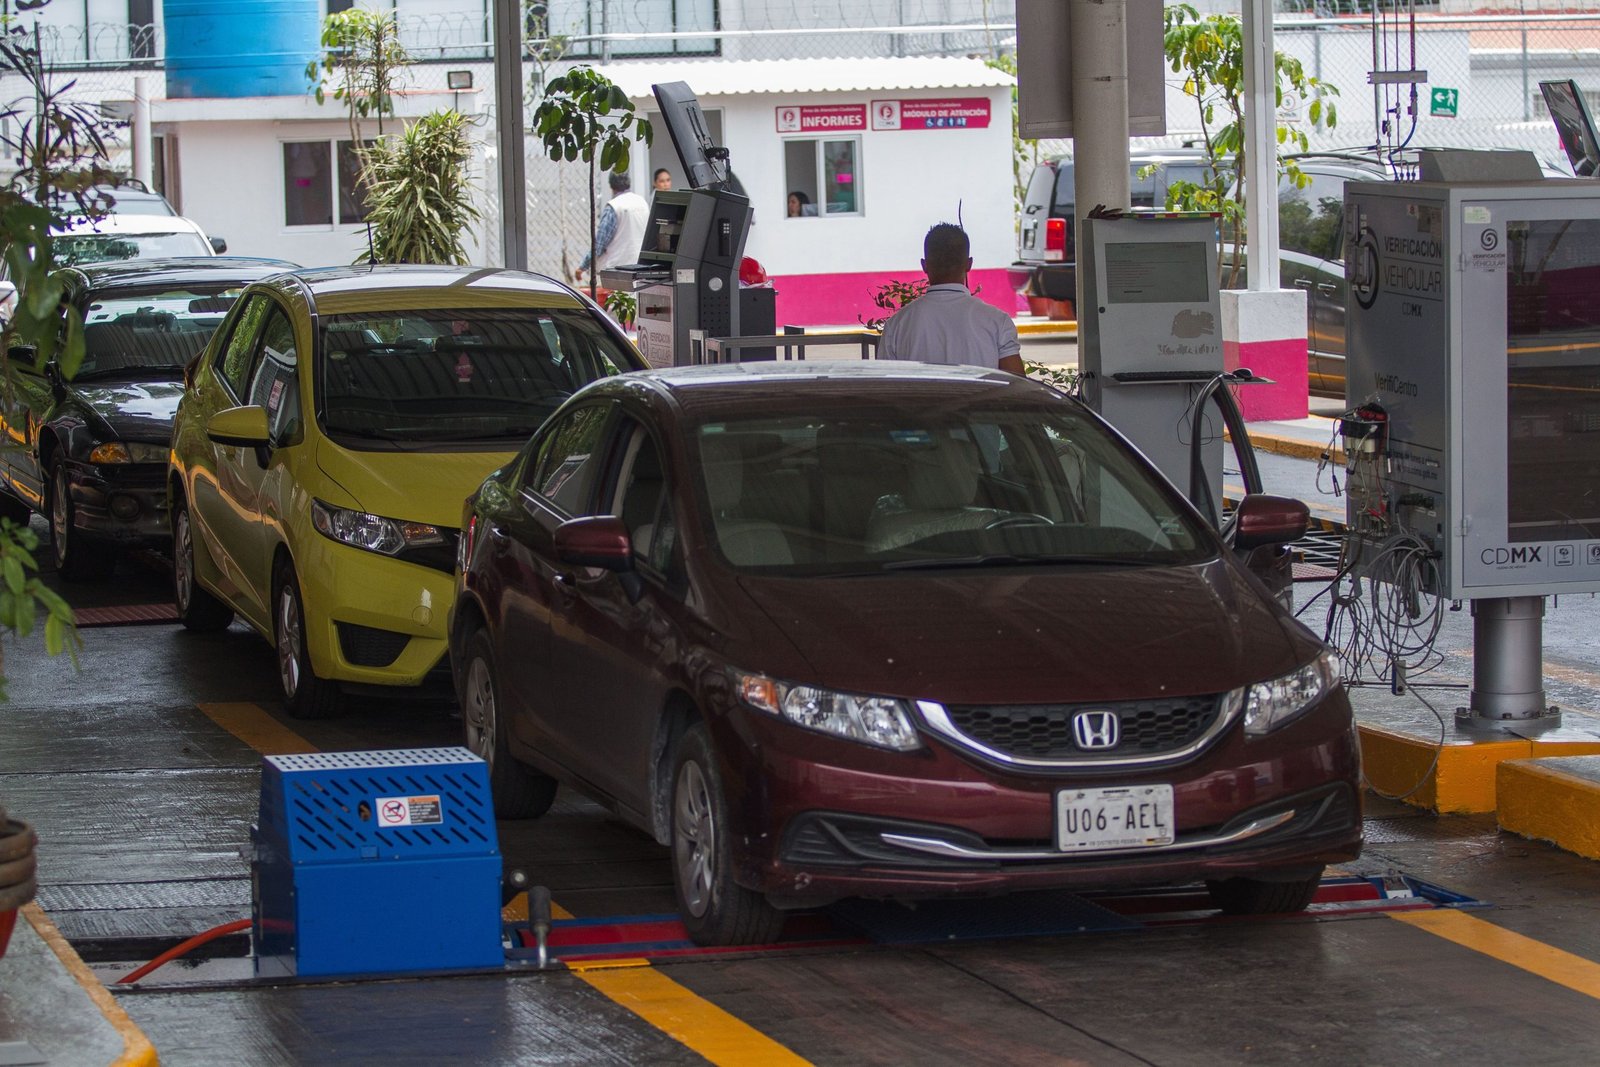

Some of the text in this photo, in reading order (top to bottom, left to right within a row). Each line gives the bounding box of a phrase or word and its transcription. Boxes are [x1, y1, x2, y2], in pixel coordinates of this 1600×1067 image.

[802, 115, 862, 127] INFORMES
[903, 108, 988, 118] MÓDULO DE ATENCIÓN
[1384, 264, 1442, 293] VEHICULAR
[1402, 302, 1422, 317] CDMX
[1374, 371, 1418, 397] VerifiCentro
[1481, 546, 1542, 565] CDMX
[1066, 803, 1165, 834] U06-AEL
